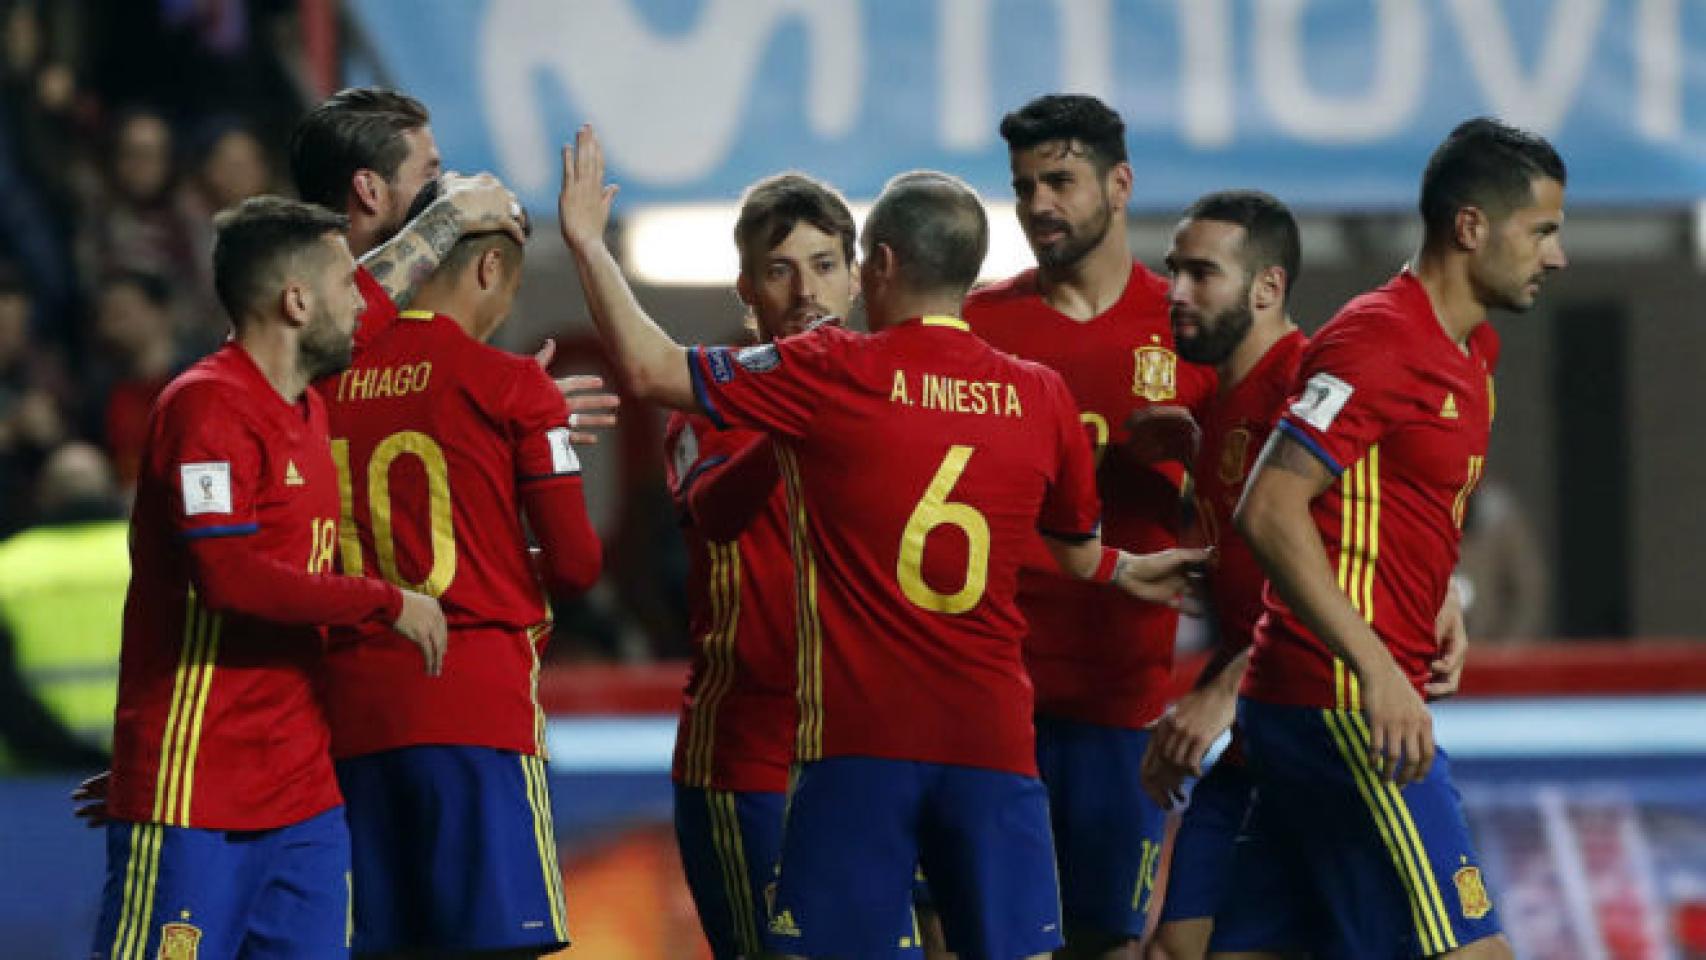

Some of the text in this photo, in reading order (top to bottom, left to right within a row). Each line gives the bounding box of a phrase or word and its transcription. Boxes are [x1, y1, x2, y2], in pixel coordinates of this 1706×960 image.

[337, 362, 432, 402] THIAGO
[889, 369, 1022, 418] A. INIESTA
[331, 431, 457, 597] 10
[897, 445, 990, 614] 6
